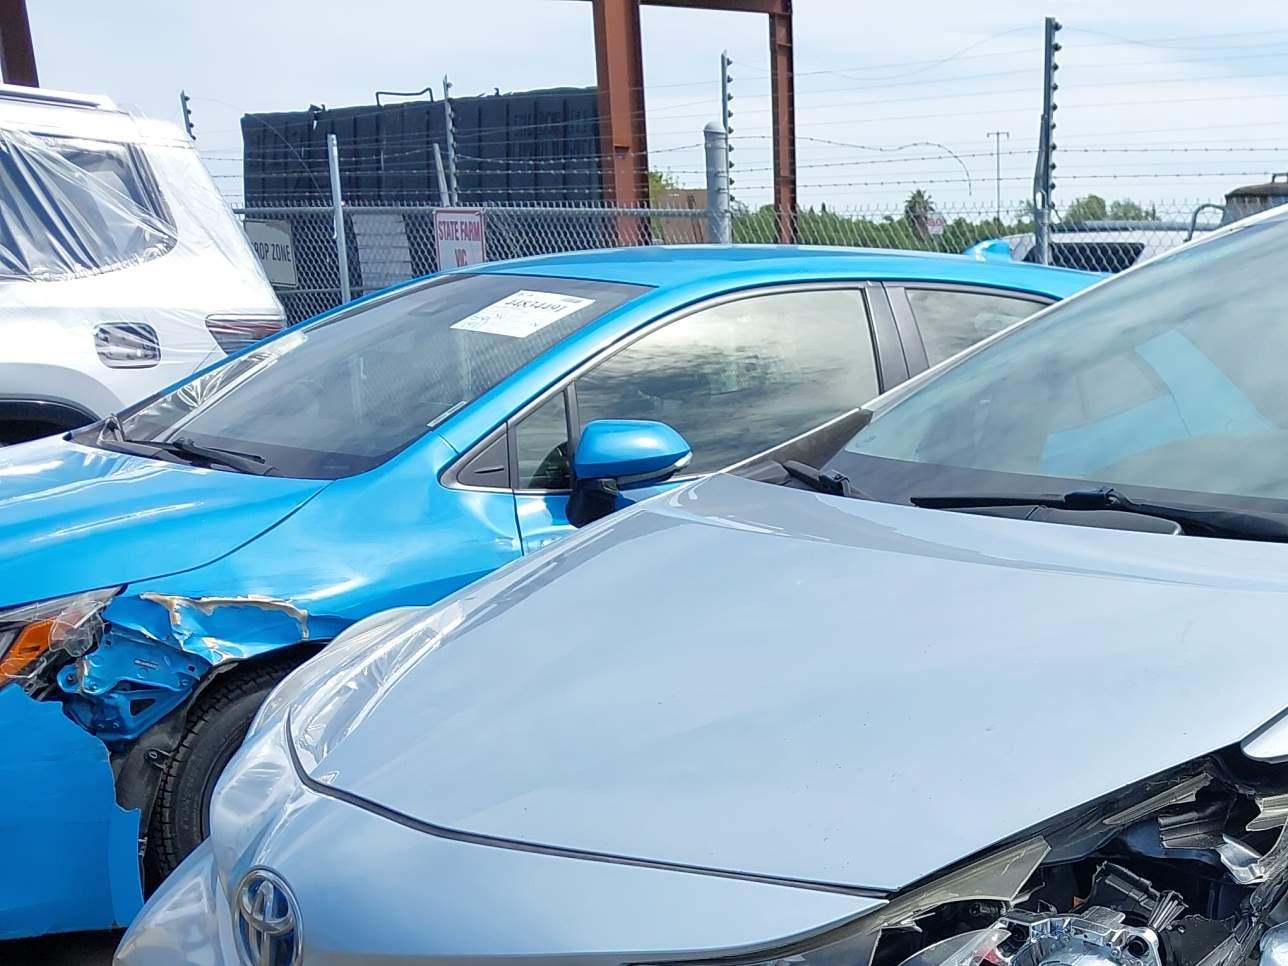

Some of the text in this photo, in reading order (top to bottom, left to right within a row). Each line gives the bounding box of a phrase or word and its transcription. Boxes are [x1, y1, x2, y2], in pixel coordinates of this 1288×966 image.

[438, 220, 481, 241] STATE FARM
[251, 241, 291, 262] ROP ZONE
